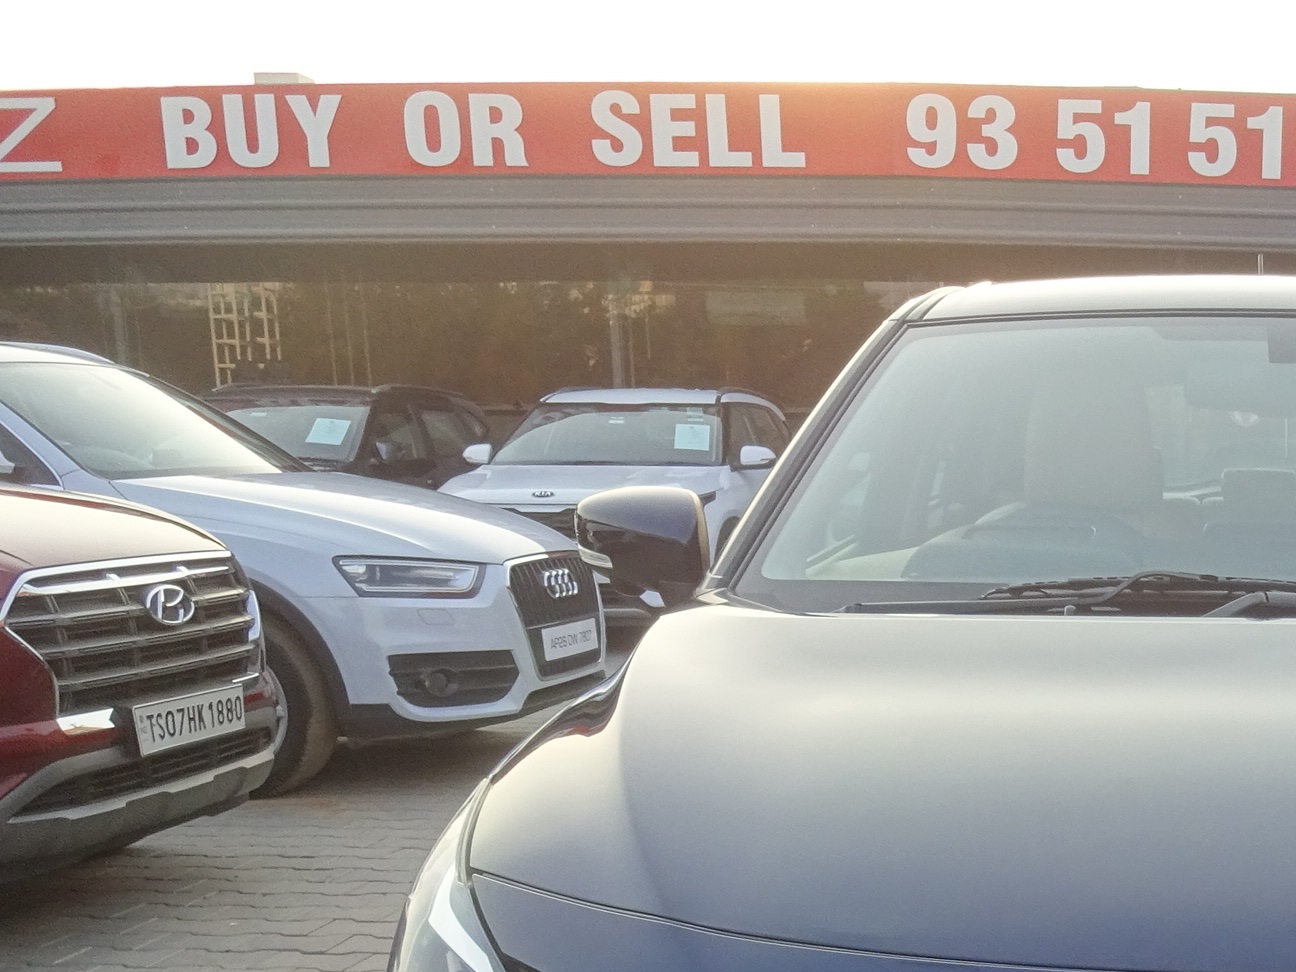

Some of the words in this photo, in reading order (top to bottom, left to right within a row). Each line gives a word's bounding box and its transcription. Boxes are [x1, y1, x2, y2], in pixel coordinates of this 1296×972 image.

[160, 92, 343, 171] BUY
[404, 90, 529, 168] OR
[590, 89, 807, 169] SELL
[905, 92, 1019, 170] 93
[1055, 98, 1151, 175] 51
[1187, 102, 1284, 180] 51
[146, 695, 243, 743] TS07HK1880
